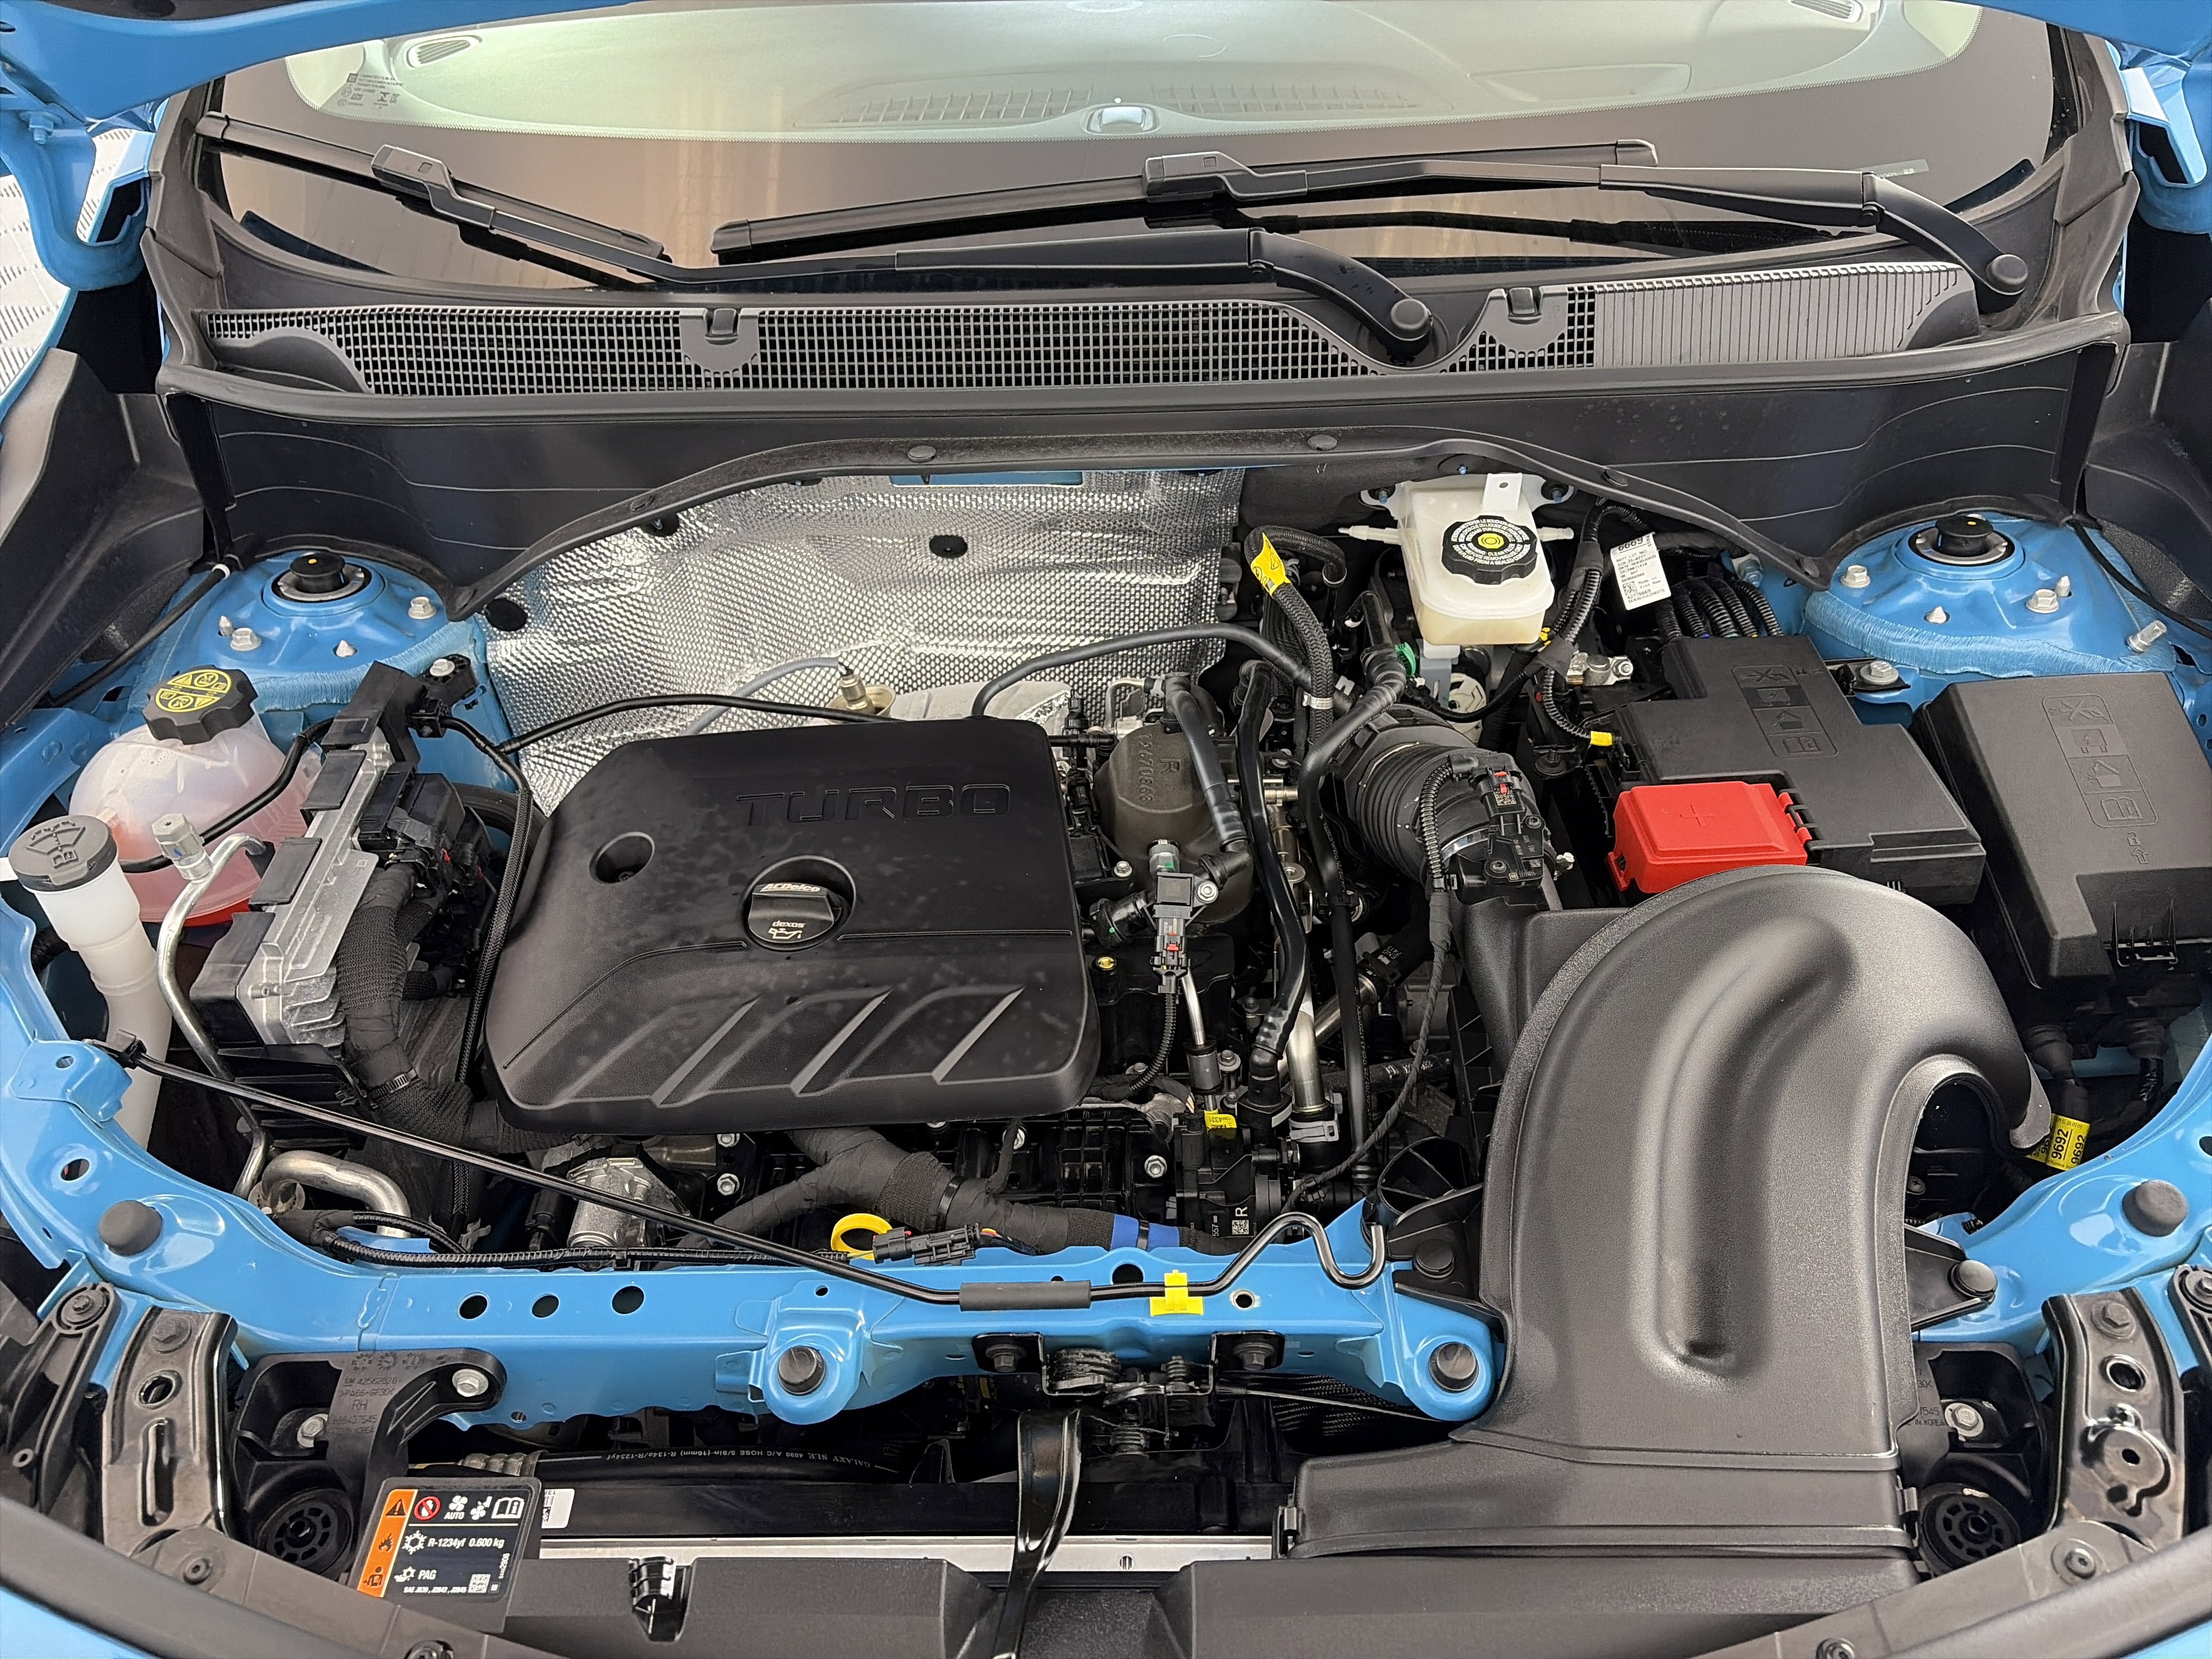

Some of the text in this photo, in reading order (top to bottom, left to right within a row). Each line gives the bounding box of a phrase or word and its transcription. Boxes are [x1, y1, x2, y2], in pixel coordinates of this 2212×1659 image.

[1160, 758, 1181, 774] R
[736, 783, 1011, 826] TURBO
[760, 883, 821, 893] ACDelco
[2051, 1128, 2069, 1160] 9692
[2070, 1134, 2085, 1164] 9692
[1235, 1206, 1248, 1217] R
[351, 1400, 369, 1410] RH
[809, 1452, 828, 1460] SLE
[833, 1455, 871, 1468] GALAXY
[444, 1511, 465, 1520] AUTO
[427, 1538, 505, 1549] R-1234yf 0.600 kg
[418, 1570, 437, 1580] PAG
